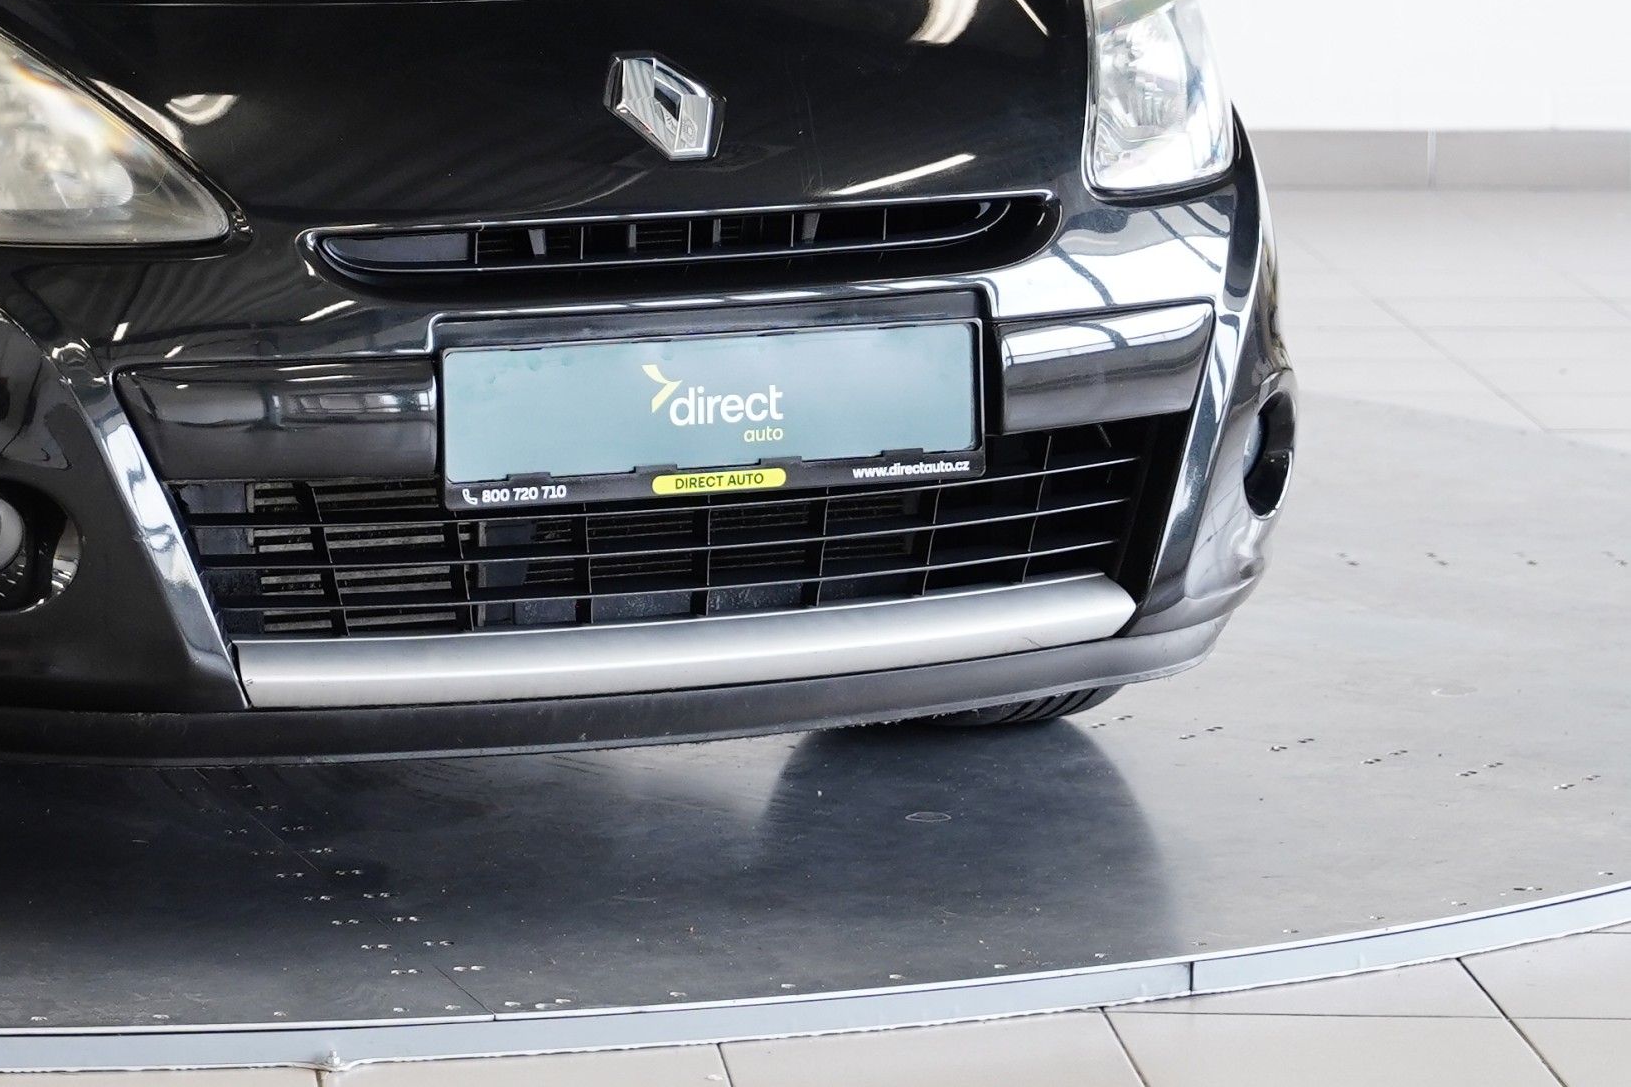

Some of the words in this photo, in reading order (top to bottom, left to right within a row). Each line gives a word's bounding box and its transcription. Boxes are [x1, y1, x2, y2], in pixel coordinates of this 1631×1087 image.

[669, 384, 784, 426] direct
[743, 426, 784, 442] auto
[852, 460, 970, 479] www.directauto.cz
[675, 475, 724, 490] DIRECT
[727, 472, 764, 486] AUTO
[481, 488, 510, 503] 800
[512, 486, 538, 501] 720
[540, 484, 567, 499] 710
